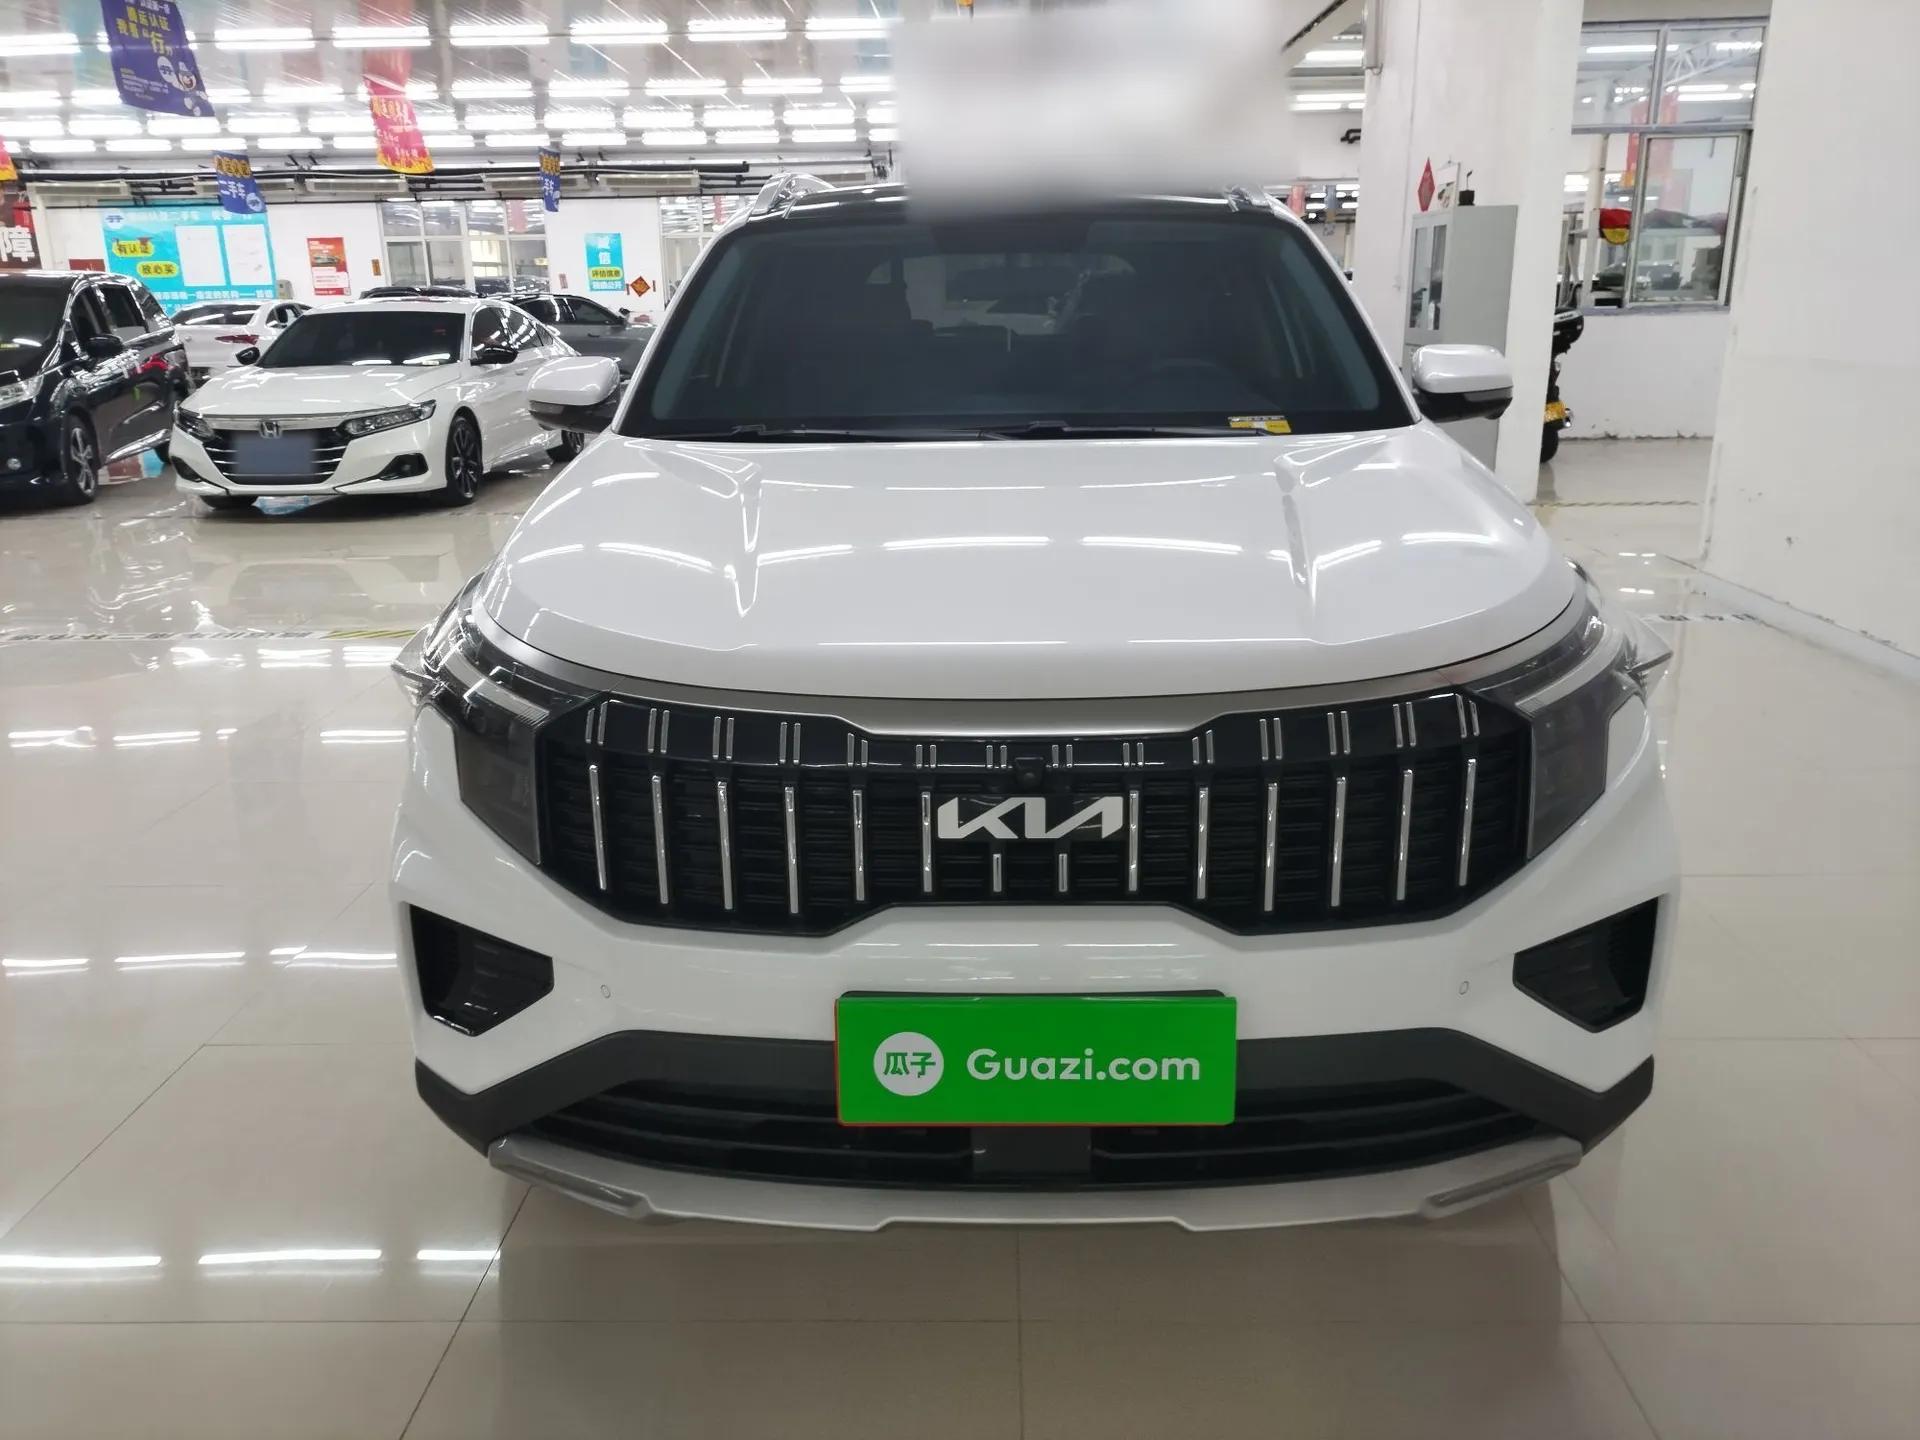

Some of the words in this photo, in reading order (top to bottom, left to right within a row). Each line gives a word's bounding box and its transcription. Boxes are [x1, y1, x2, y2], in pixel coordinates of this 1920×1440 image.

[938, 796, 1124, 839] KIA
[883, 1051, 936, 1078] 瓜子
[966, 1048, 1200, 1081] Guazi.com
